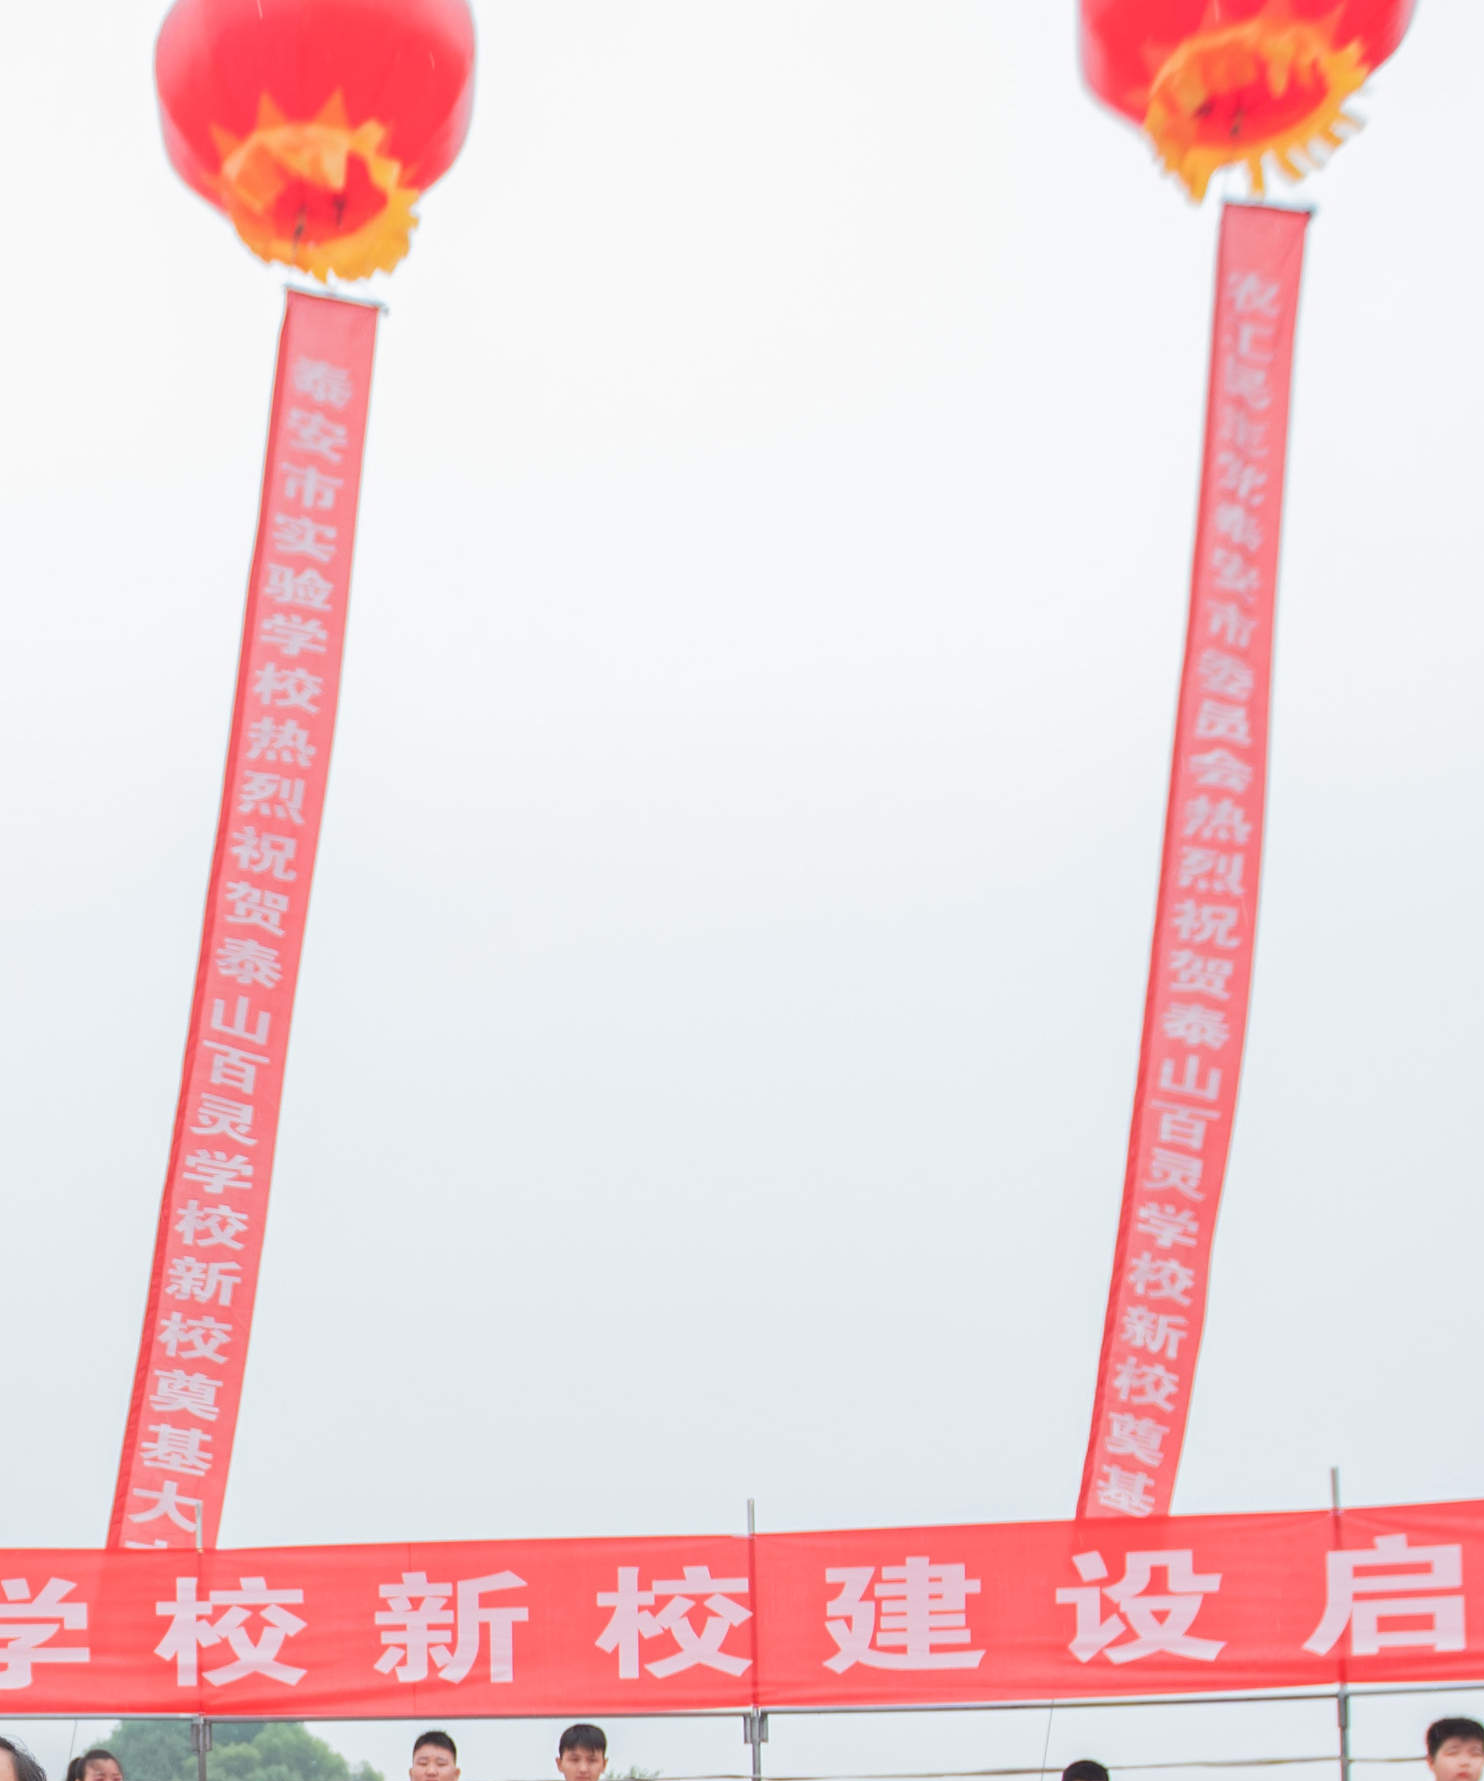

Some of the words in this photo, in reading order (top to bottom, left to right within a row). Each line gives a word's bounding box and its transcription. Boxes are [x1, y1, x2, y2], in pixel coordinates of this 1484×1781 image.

[125, 356, 352, 1549] 泰安市实验学校热烈祝贺泰山百灵学校新校奠基大
